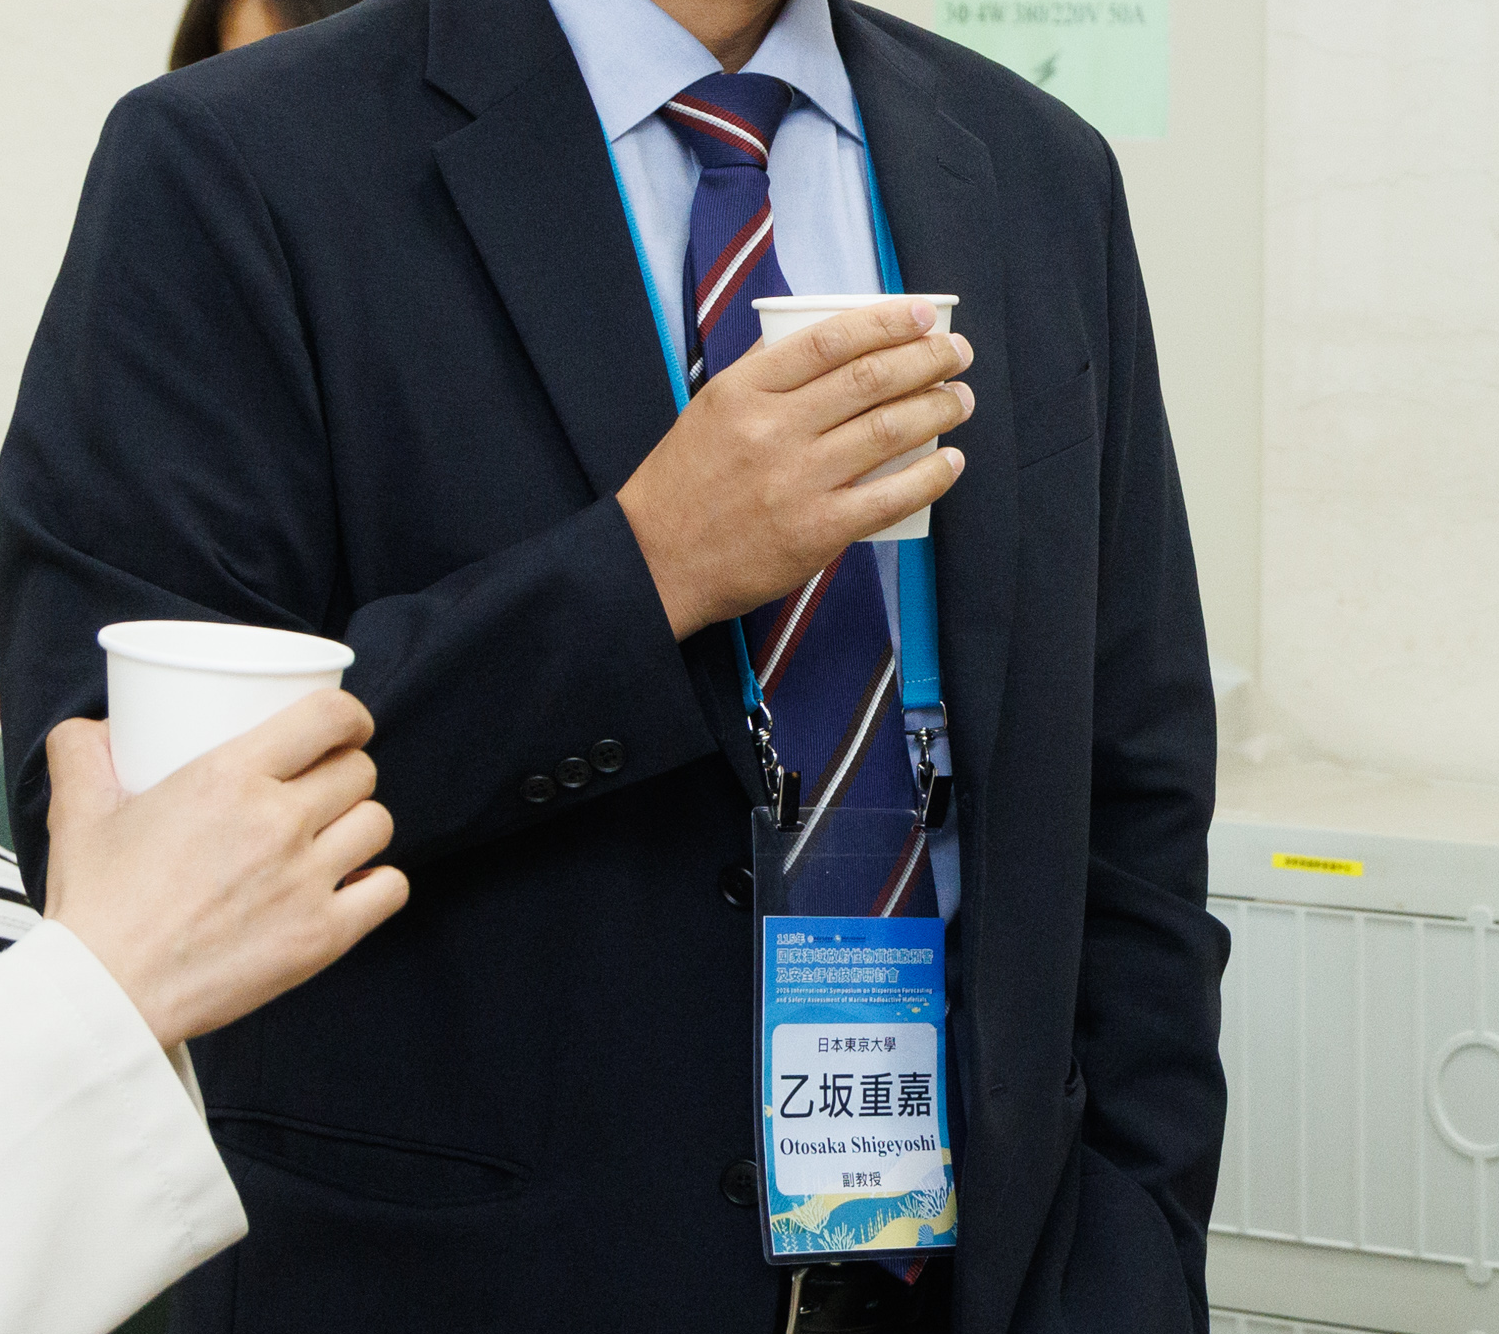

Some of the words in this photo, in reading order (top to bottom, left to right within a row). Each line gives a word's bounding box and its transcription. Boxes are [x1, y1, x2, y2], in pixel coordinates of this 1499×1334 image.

[776, 932, 805, 946] 115年
[776, 967, 899, 984] 及安全評估技術研討會
[829, 987, 862, 995] Symposium
[871, 987, 901, 995] Dispersion
[901, 987, 933, 995] Forecasting
[787, 996, 807, 1004] Safety
[818, 1036, 897, 1053] 日本東京大學
[780, 1072, 933, 1119] 乙坂重嘉
[780, 1137, 847, 1156] Otosaka
[851, 1134, 937, 1158] Shigeyoshi
[842, 1171, 883, 1188] 副教授
